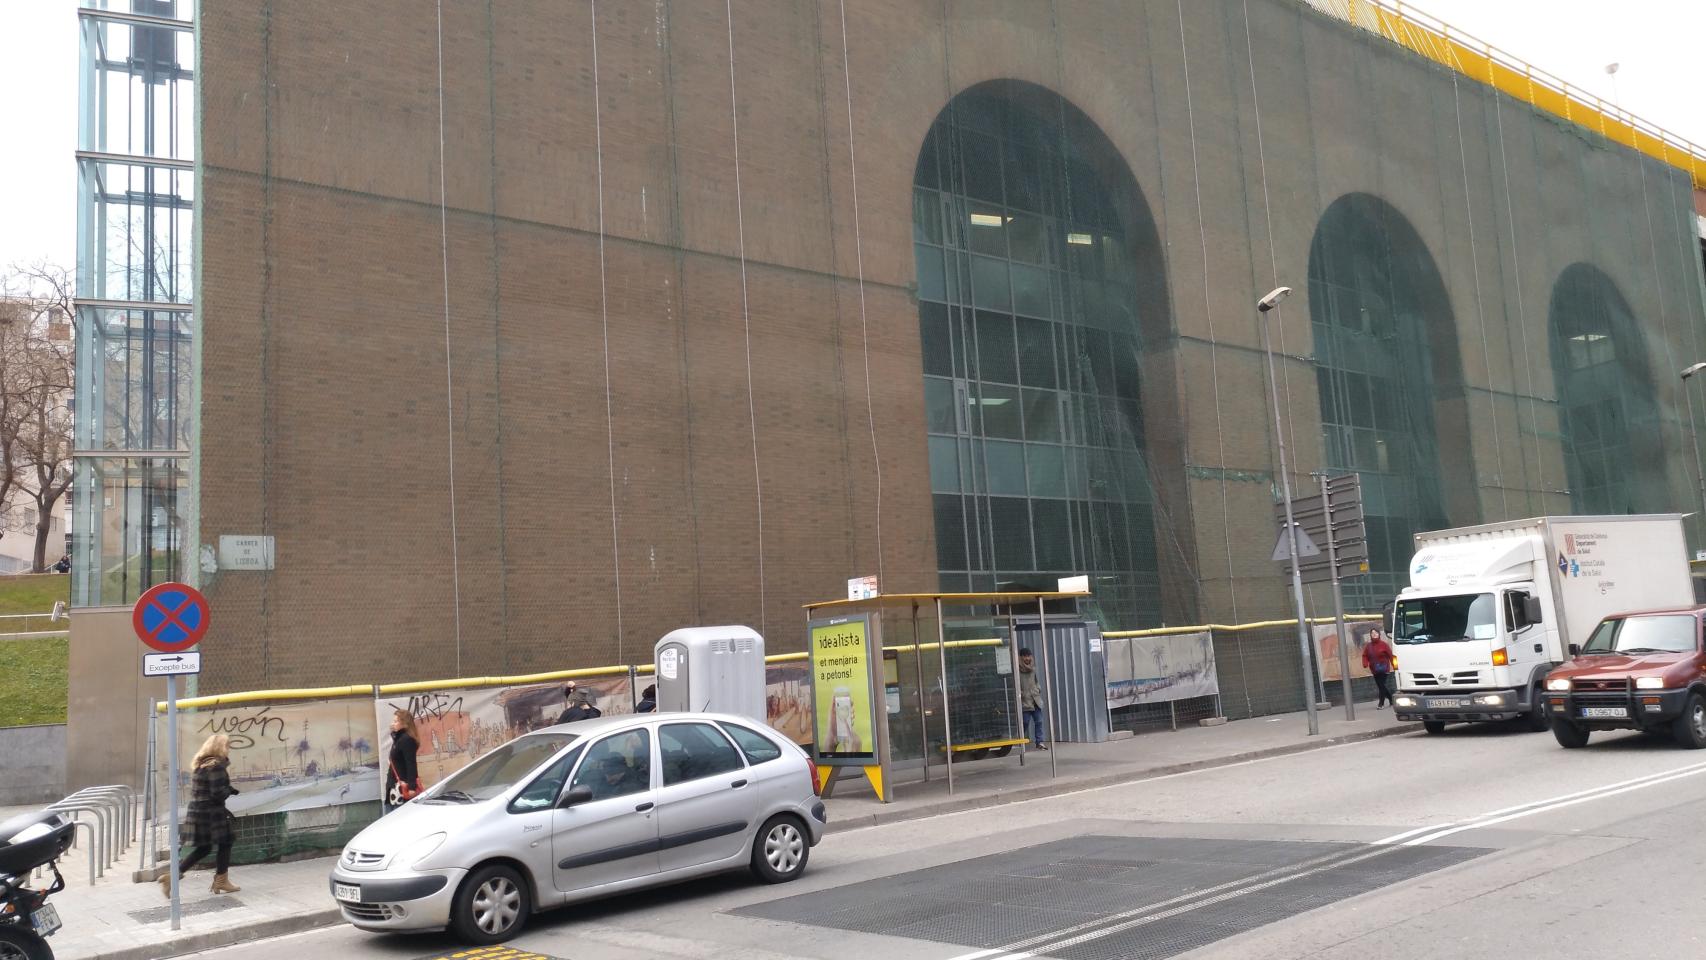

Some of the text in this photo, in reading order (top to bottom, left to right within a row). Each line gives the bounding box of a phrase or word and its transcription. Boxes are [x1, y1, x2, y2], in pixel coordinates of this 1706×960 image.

[235, 558, 259, 566] LISBOA
[819, 632, 860, 649] idealista
[820, 655, 858, 667] et menjaria
[149, 663, 181, 672] Excepte
[820, 667, 852, 682] a petons!
